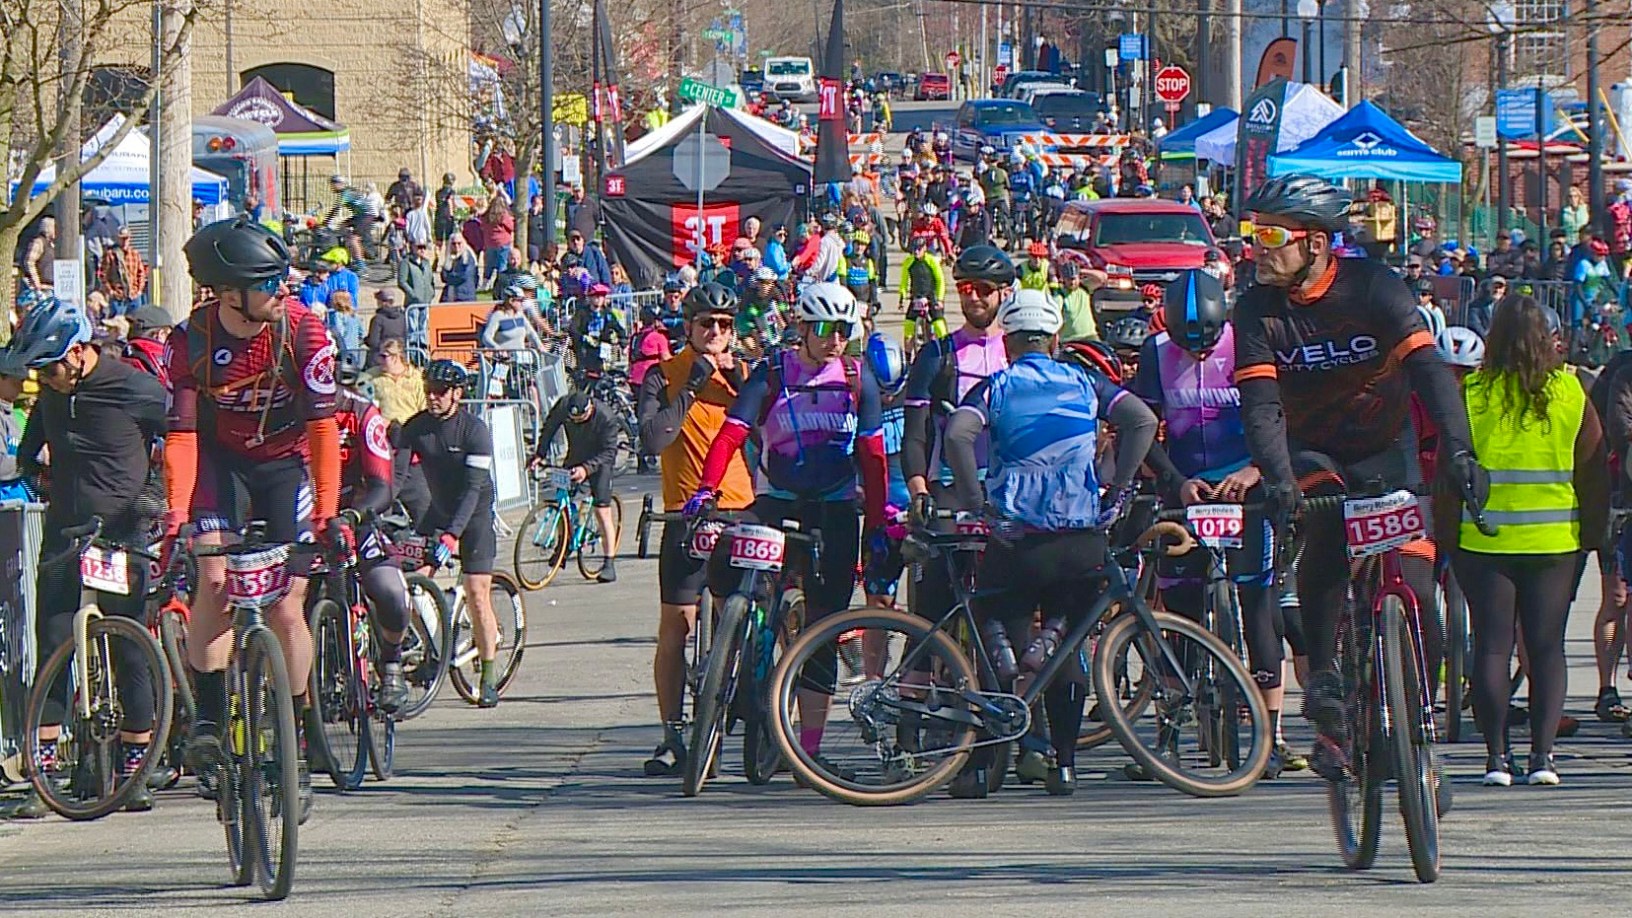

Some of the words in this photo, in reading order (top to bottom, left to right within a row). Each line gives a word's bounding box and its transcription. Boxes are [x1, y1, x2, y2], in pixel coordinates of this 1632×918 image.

[690, 83, 725, 105] CENTER
[1158, 78, 1187, 91] STOP
[1371, 148, 1398, 156] club
[608, 179, 622, 193] 3T
[684, 215, 727, 252] 3T
[1276, 335, 1377, 364] VELO
[1278, 363, 1315, 372] CITY
[1320, 349, 1380, 371] CYCLES
[1193, 519, 1241, 536] 1019
[1350, 509, 1420, 542] 1586
[735, 539, 782, 560] 1869
[228, 566, 285, 595] 1597
